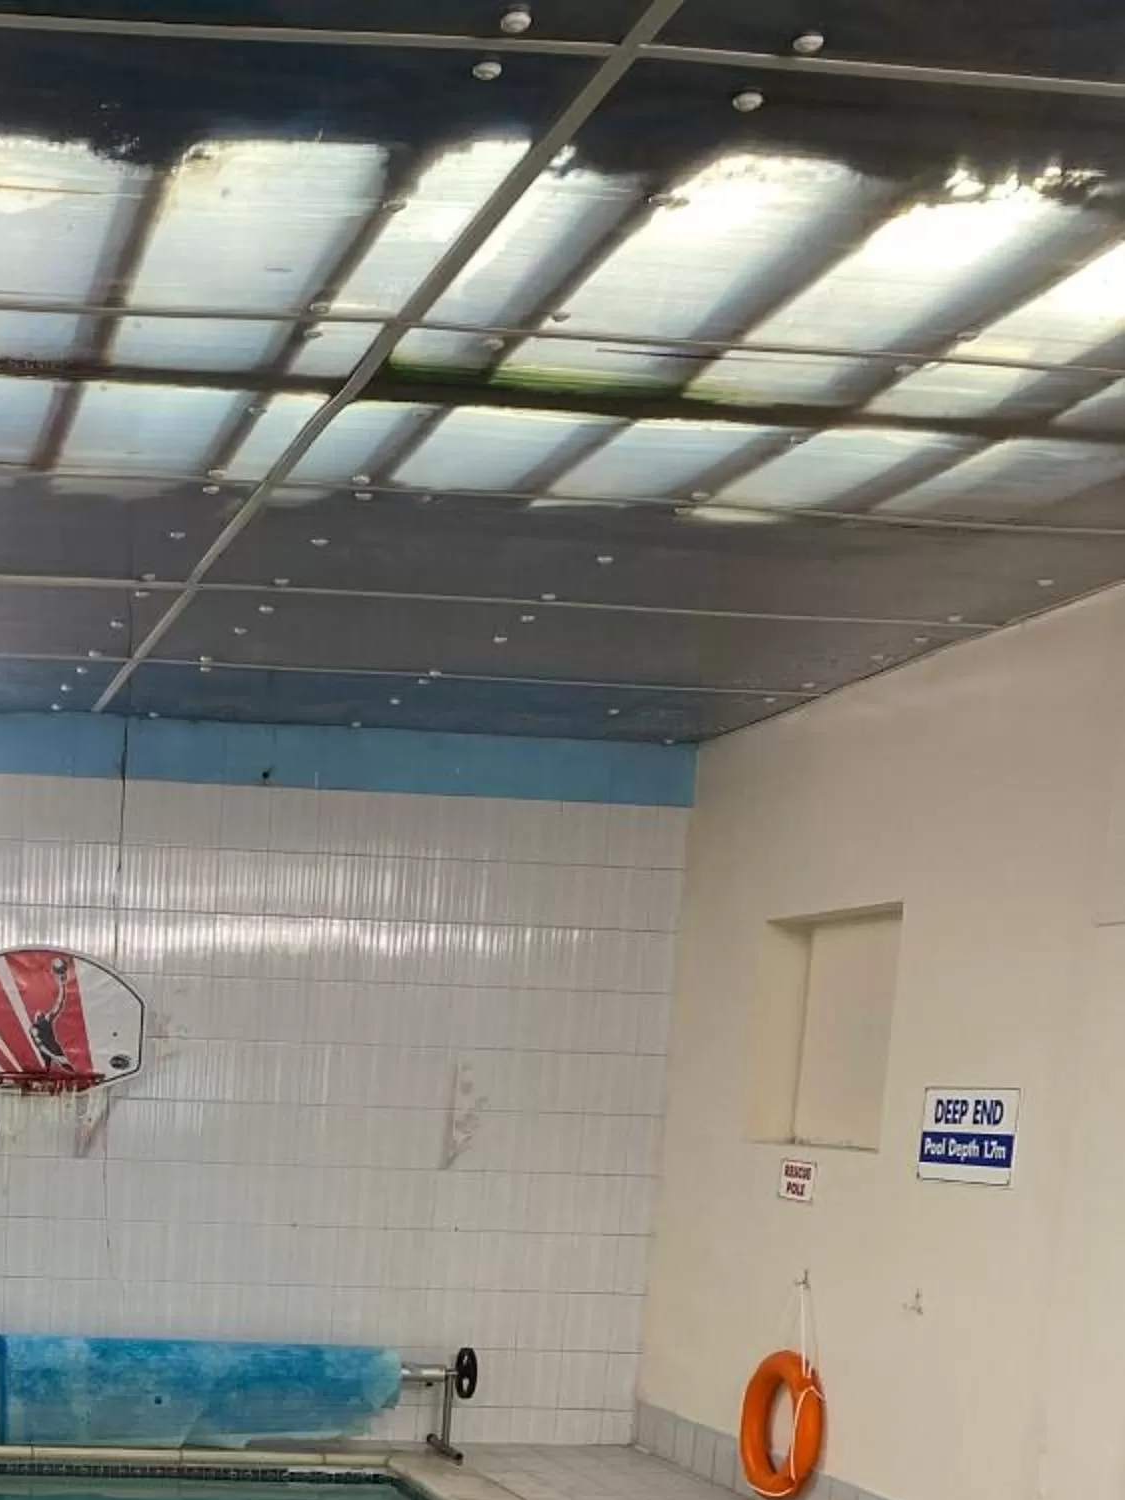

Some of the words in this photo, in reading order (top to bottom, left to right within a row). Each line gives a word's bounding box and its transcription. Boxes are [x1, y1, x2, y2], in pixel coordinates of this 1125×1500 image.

[934, 1098, 969, 1125] DEEP
[972, 1099, 1004, 1126] END
[924, 1137, 947, 1156] Pool
[948, 1137, 980, 1162] Depth
